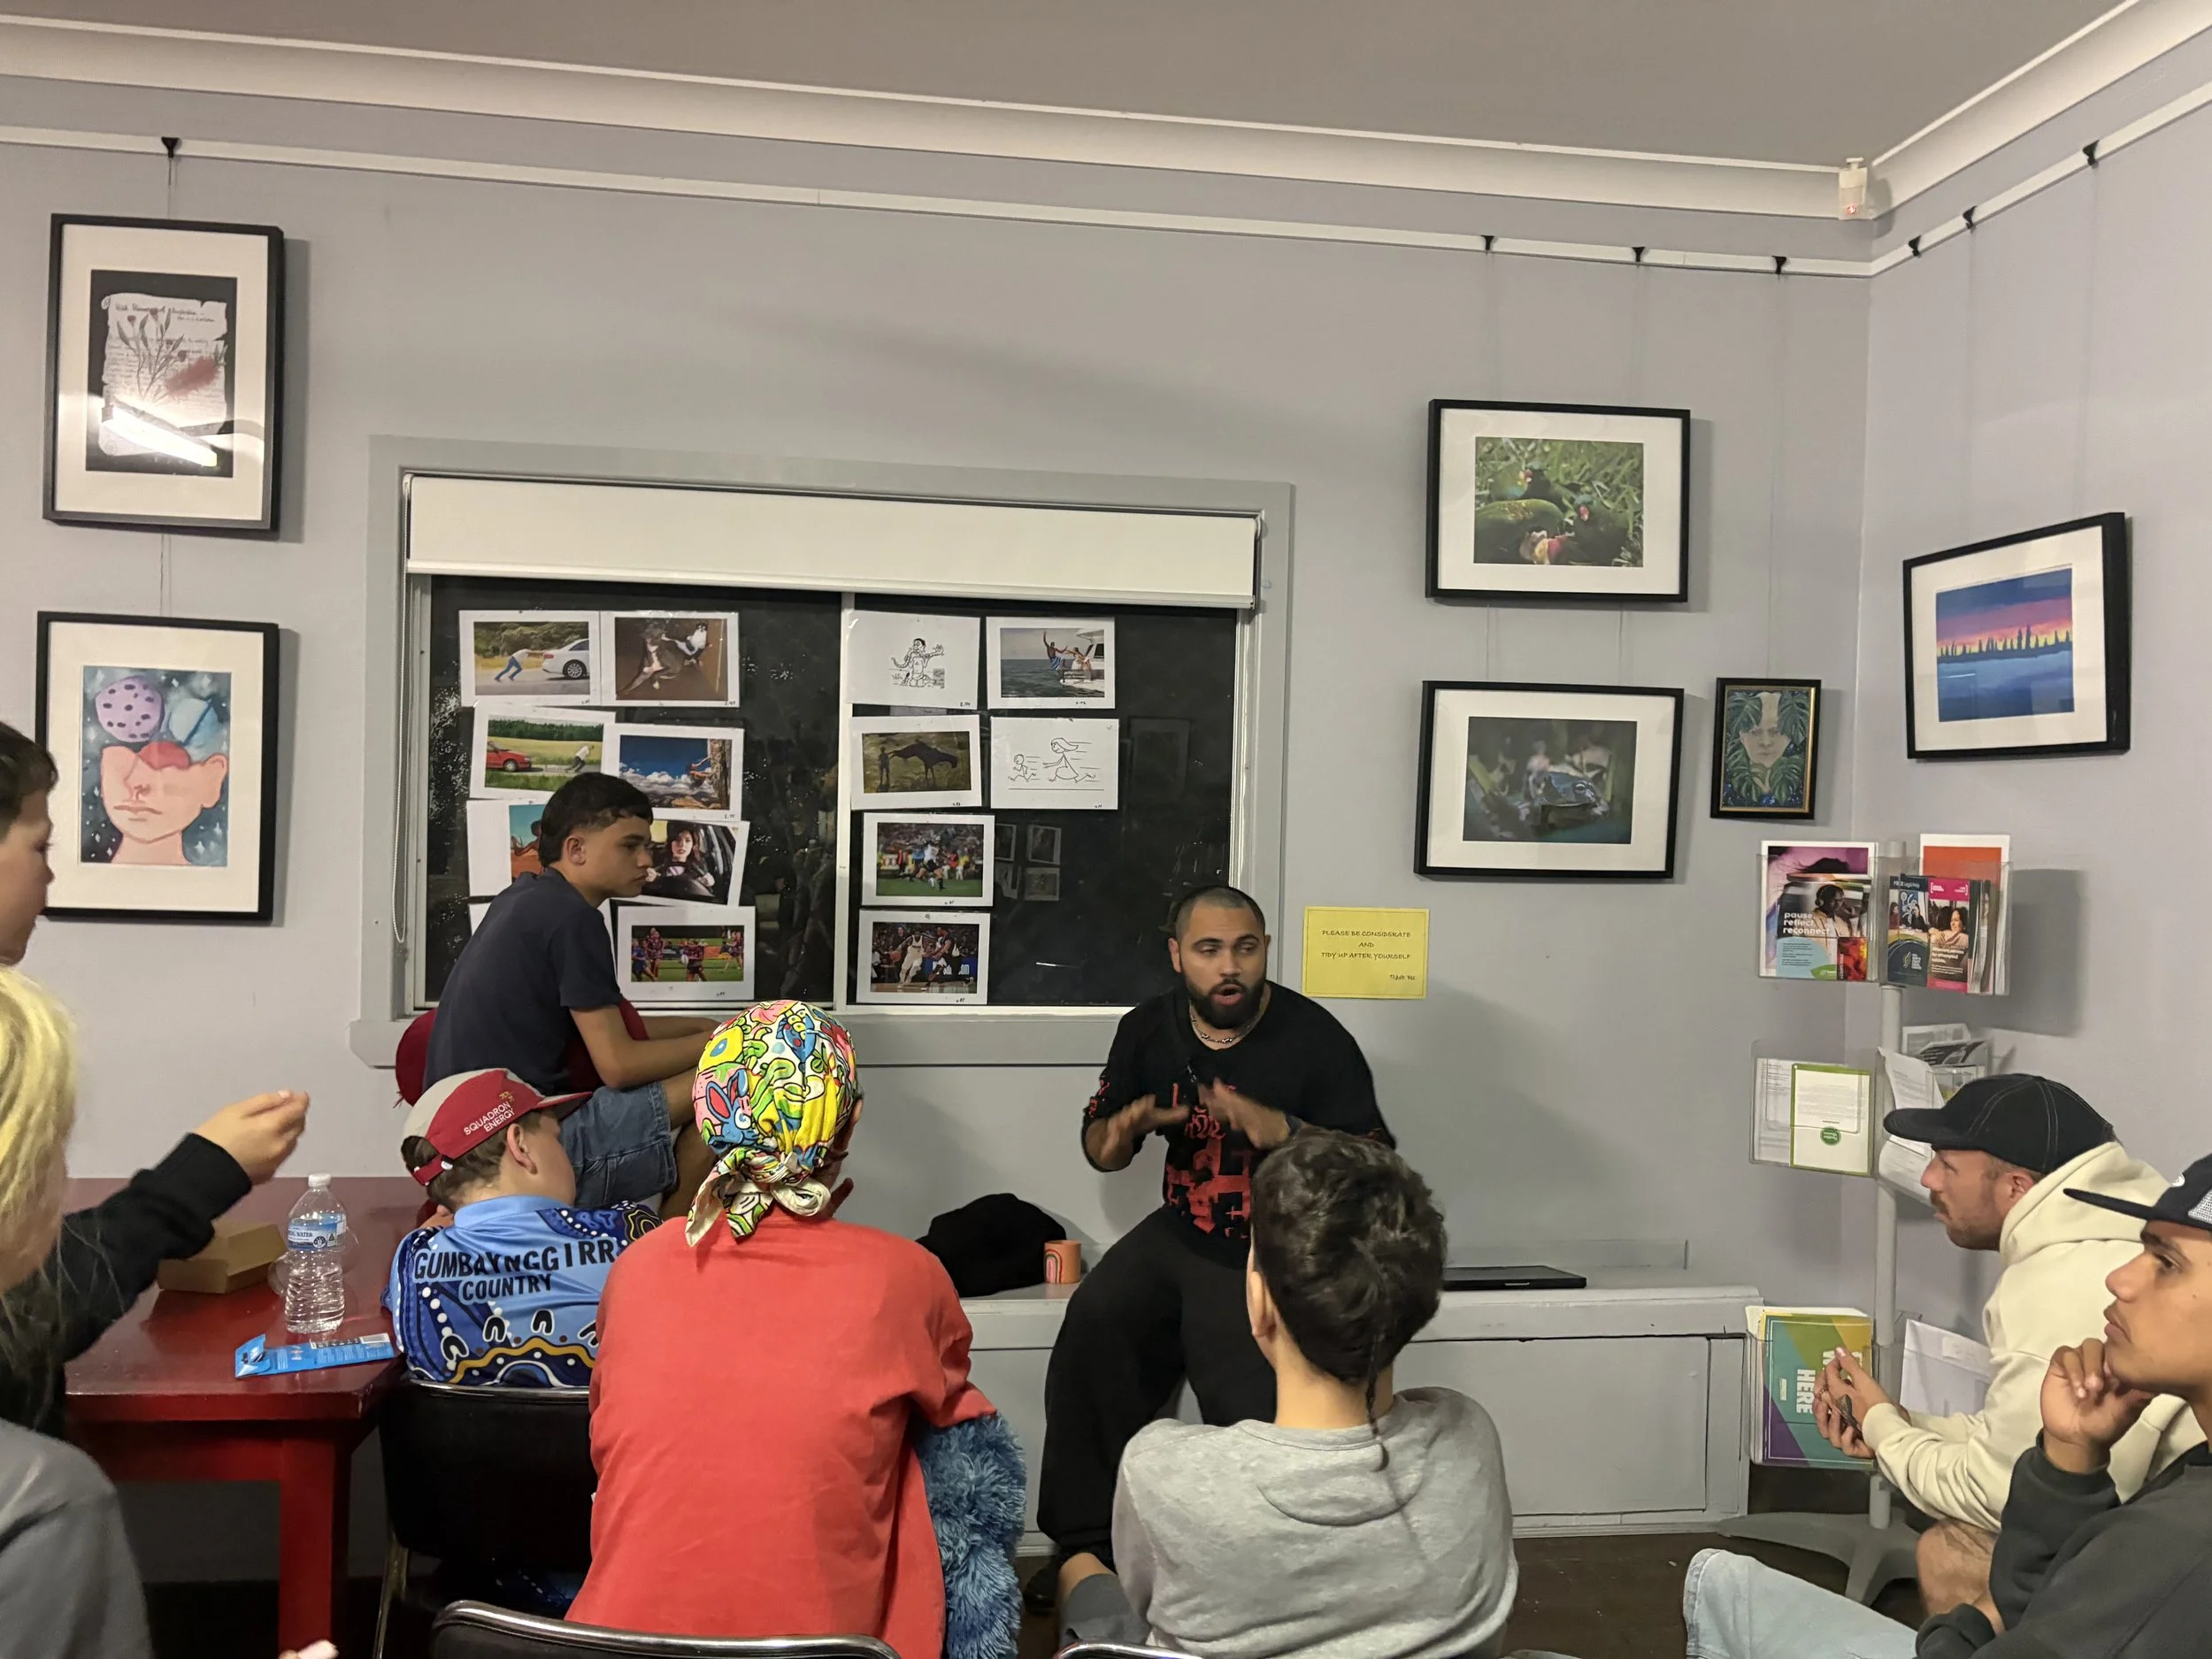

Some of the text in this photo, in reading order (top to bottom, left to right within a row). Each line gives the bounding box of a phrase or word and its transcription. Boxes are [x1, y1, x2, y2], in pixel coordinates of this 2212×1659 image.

[464, 1101, 511, 1135] SQUADRON
[483, 1108, 515, 1133] ENERGY
[462, 1274, 552, 1300] COUNTRY
[1796, 1369, 1816, 1414] HERE
